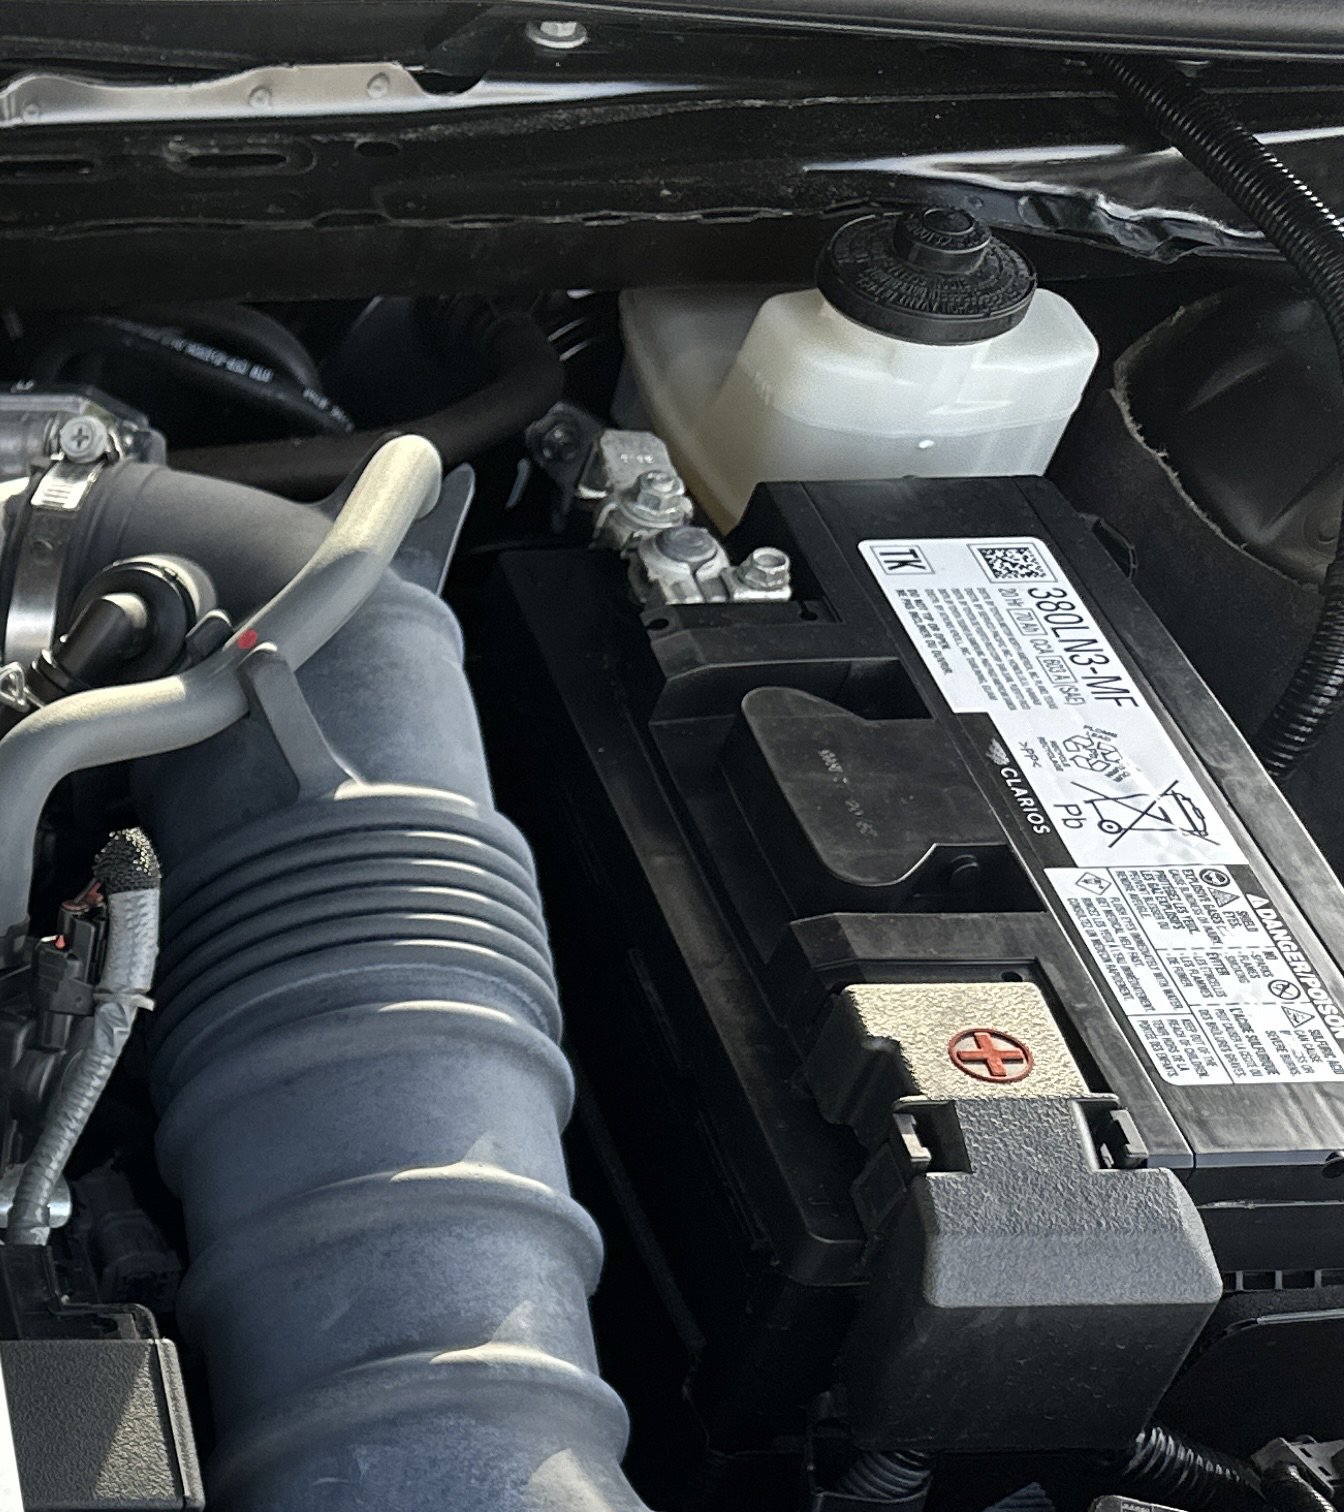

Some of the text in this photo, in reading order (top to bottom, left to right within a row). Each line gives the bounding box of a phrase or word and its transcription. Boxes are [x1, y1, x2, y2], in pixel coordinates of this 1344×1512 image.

[879, 549, 926, 570] TK
[1027, 587, 1138, 707] 380LN3-MF
[1000, 766, 1051, 834] CLARIOS
[1053, 804, 1086, 828] Pb
